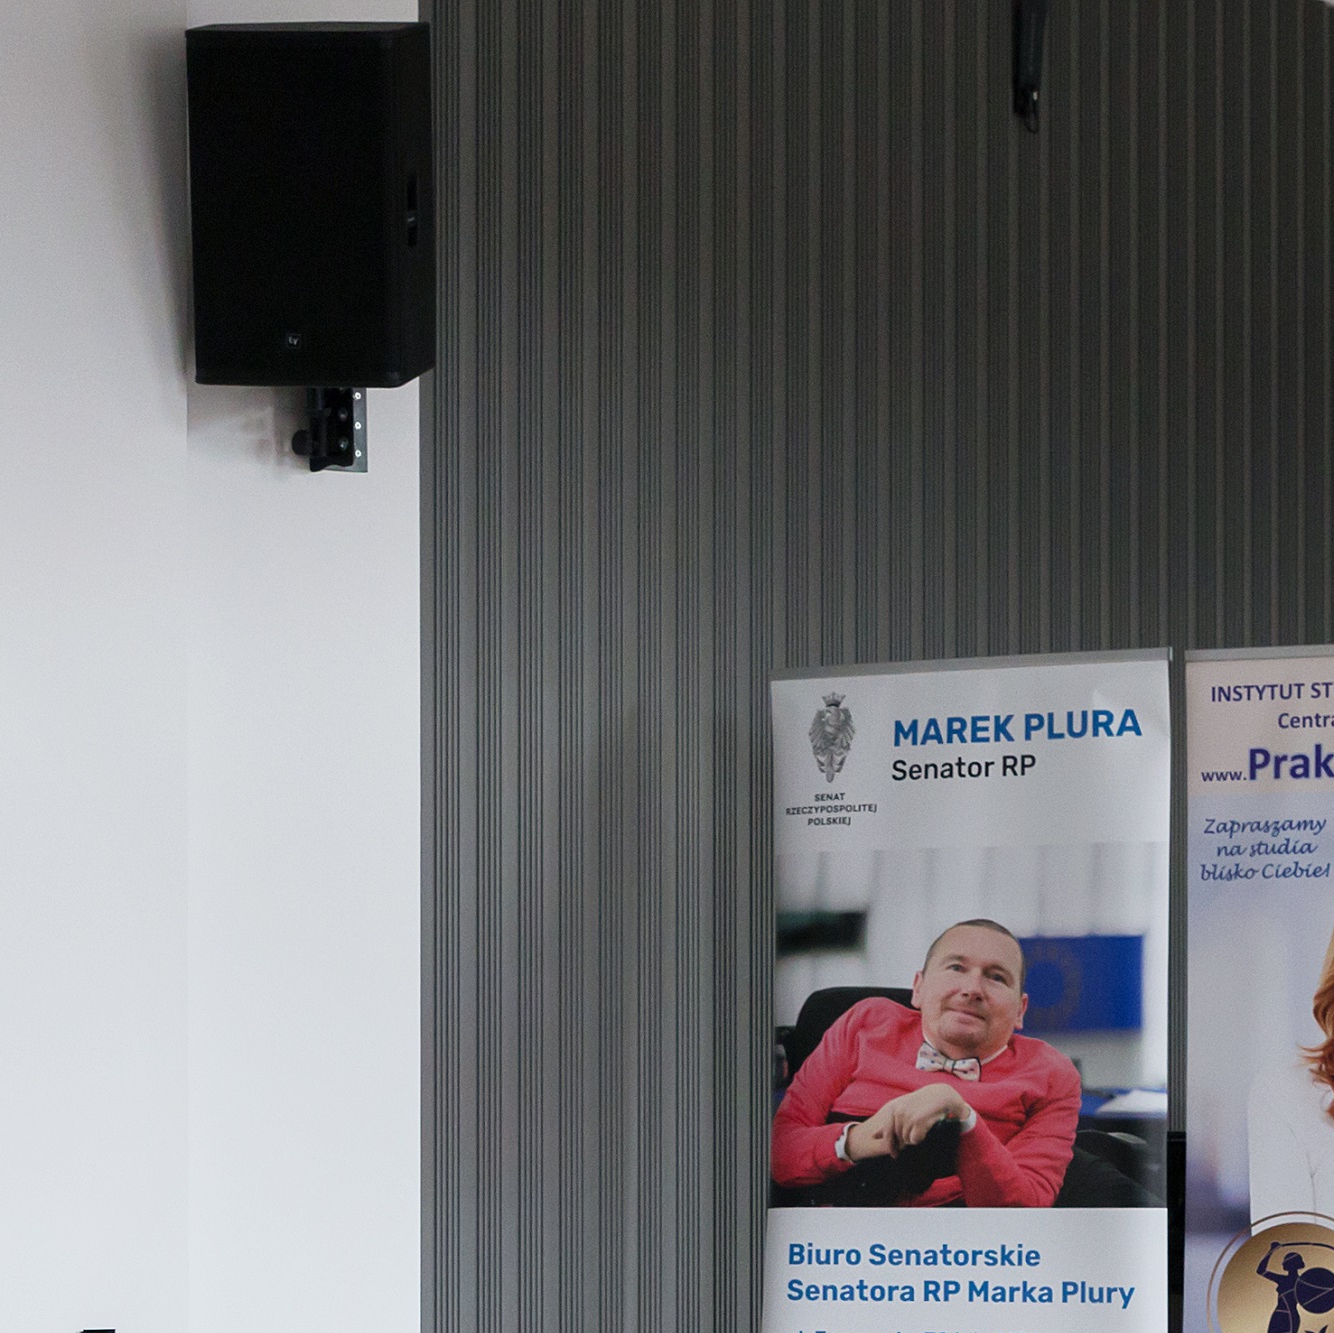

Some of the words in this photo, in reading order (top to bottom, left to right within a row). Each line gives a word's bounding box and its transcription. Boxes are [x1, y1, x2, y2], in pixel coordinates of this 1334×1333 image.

[1212, 683, 1305, 702] INSTYTUT
[894, 715, 1014, 746] MAREK
[1025, 709, 1142, 741] PLURA
[892, 757, 994, 781] Senator
[1003, 755, 1036, 776] RP
[815, 793, 845, 802] SENAT
[786, 804, 877, 815] RZECZYPOSPOLITEJ
[808, 817, 851, 826] POLSKIEJ
[1204, 819, 1326, 838] Zapraszamy
[1217, 845, 1247, 856] na
[1249, 838, 1317, 857] studia
[1201, 863, 1259, 881] blisko
[1262, 861, 1330, 879] Ciebie!
[789, 1243, 861, 1265] Biuro
[869, 1244, 1040, 1266] Senatorskie
[787, 1279, 914, 1301] Senatora
[924, 1281, 960, 1301] RP
[969, 1281, 1053, 1303] Marka
[1062, 1281, 1134, 1309] Plury
